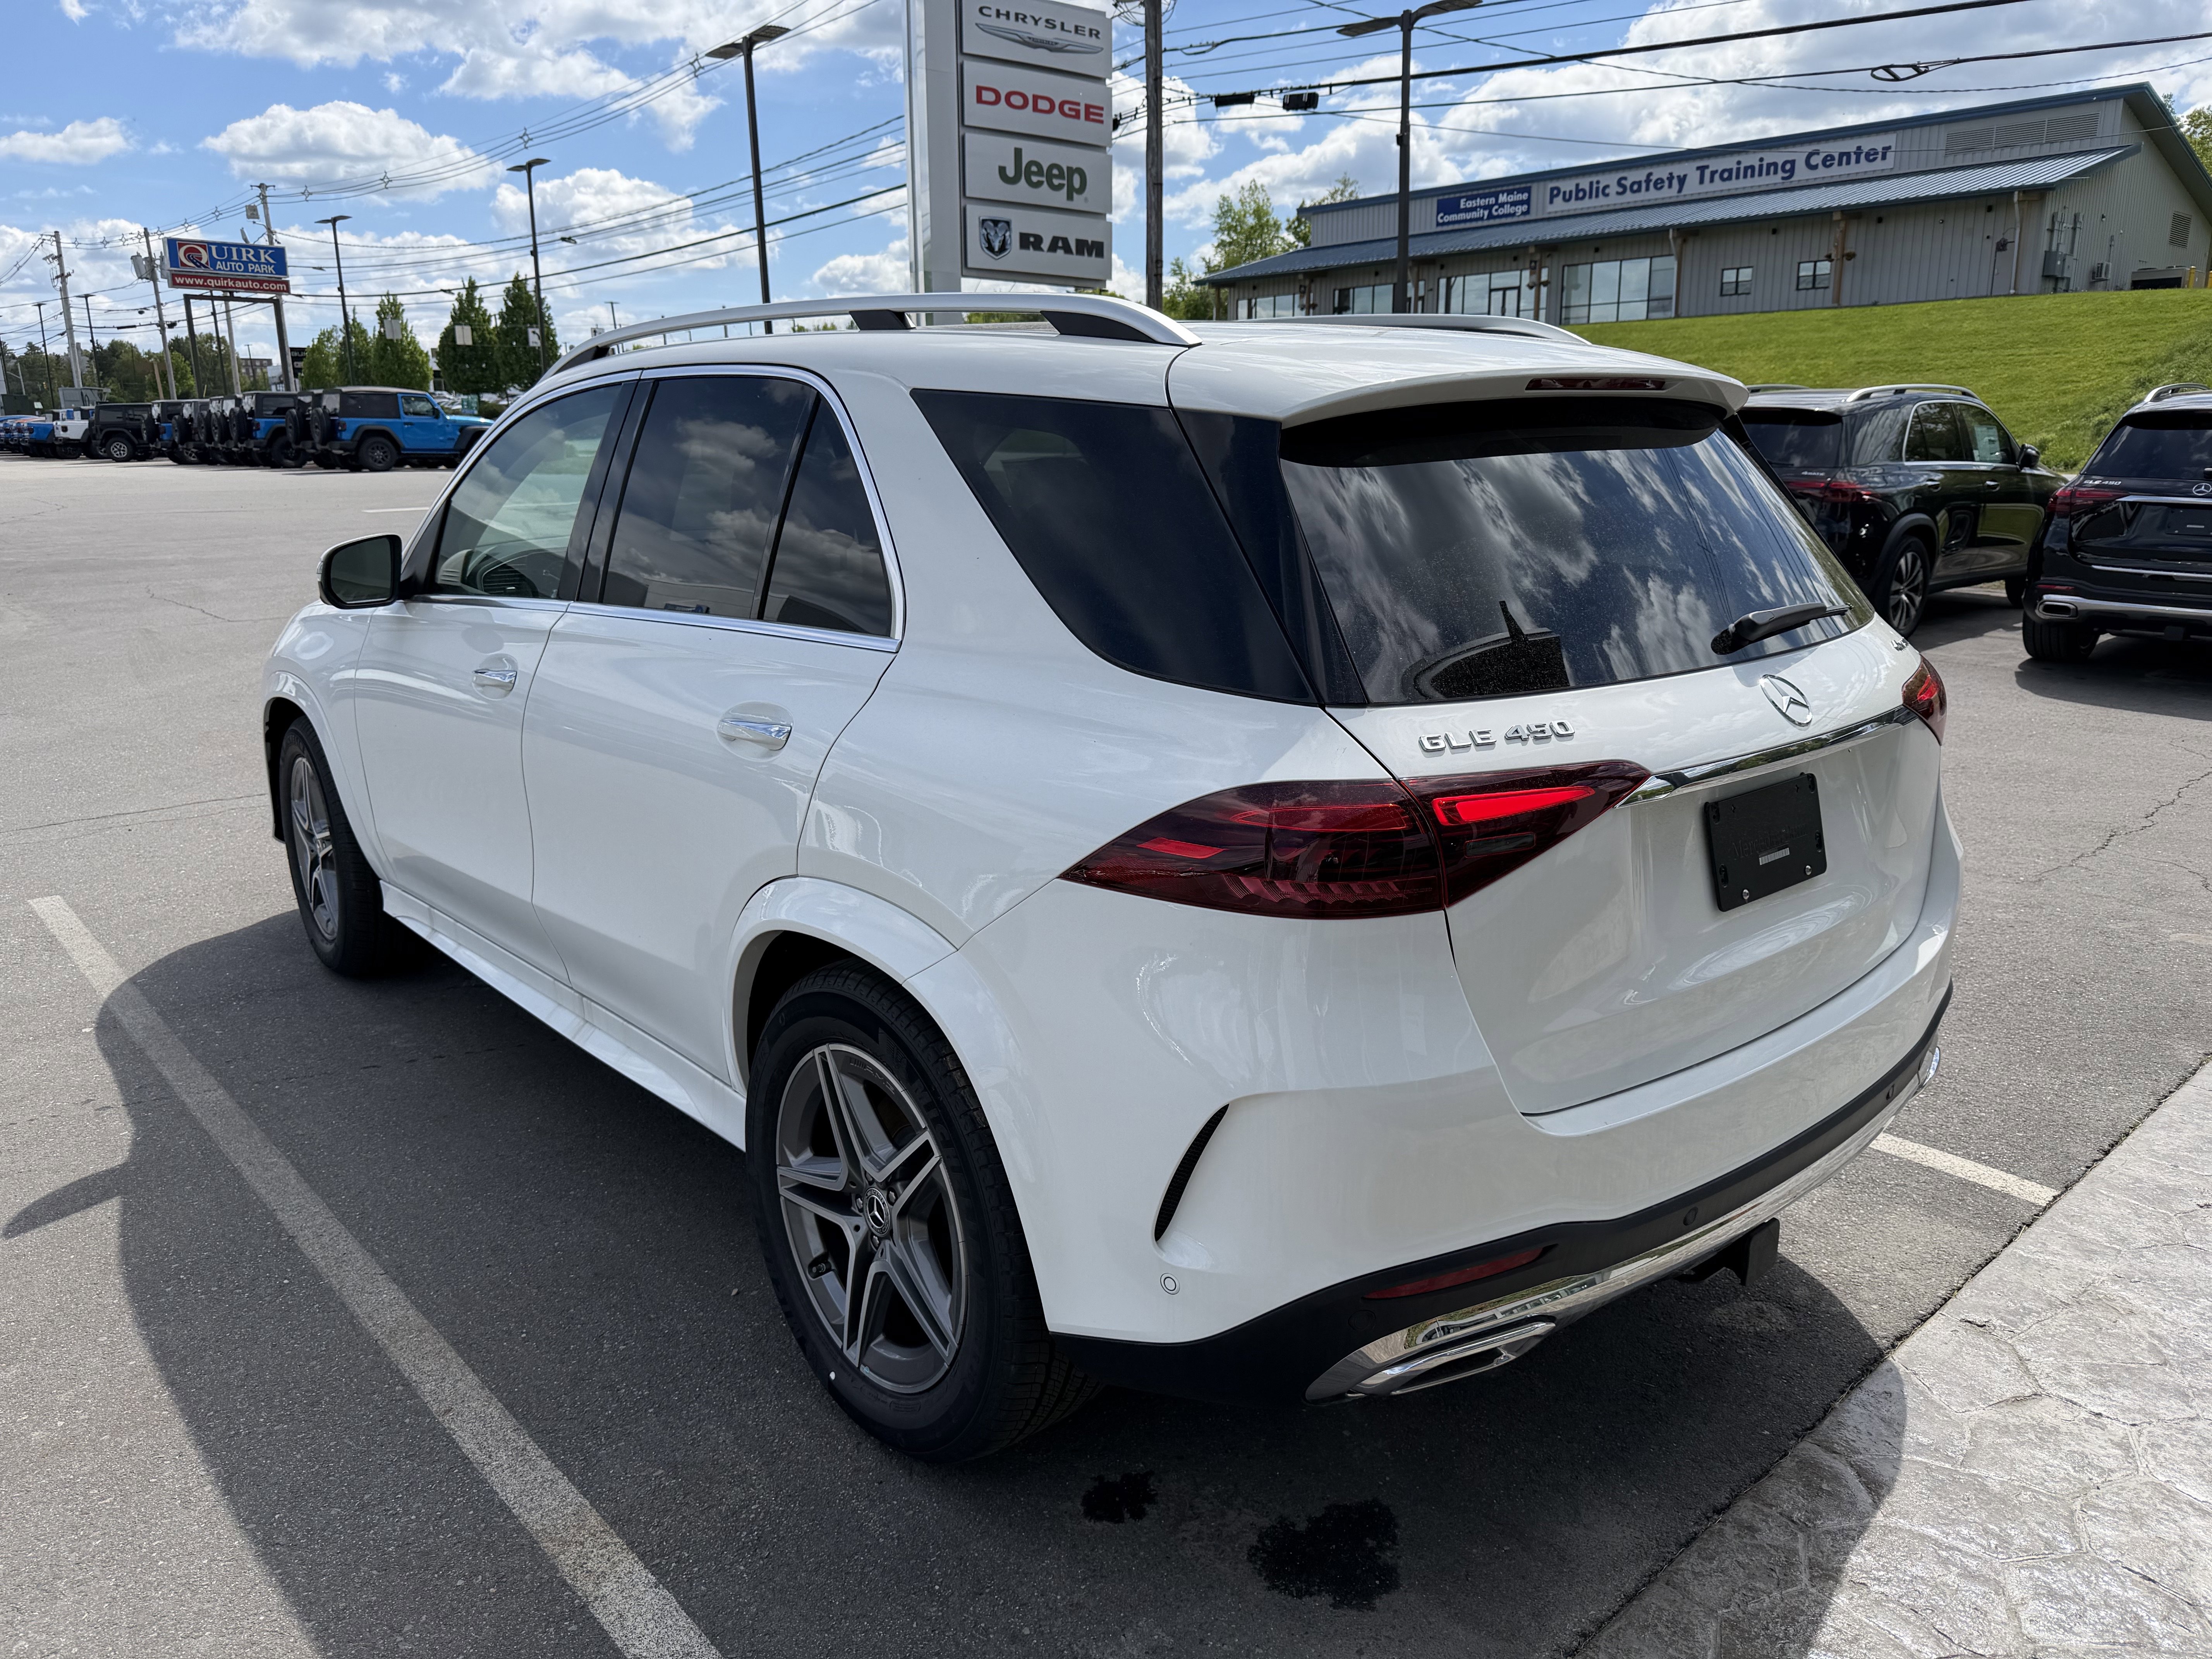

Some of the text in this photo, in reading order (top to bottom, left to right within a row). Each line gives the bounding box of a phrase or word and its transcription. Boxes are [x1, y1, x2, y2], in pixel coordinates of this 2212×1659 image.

[978, 5, 1101, 40] CHRYSLER
[976, 85, 1104, 124] DODGE
[998, 147, 1087, 201] Jeep
[1549, 145, 1893, 205] Public Safety Training Center
[1437, 204, 1528, 223] Community College
[1460, 191, 1529, 209] Eastern Maine
[179, 244, 276, 268] QUIRK
[1019, 232, 1104, 259] RAM
[216, 261, 275, 274] AUTO PARK
[175, 276, 287, 290] www.quirkauto.com
[1418, 720, 1575, 751] GLE 450
